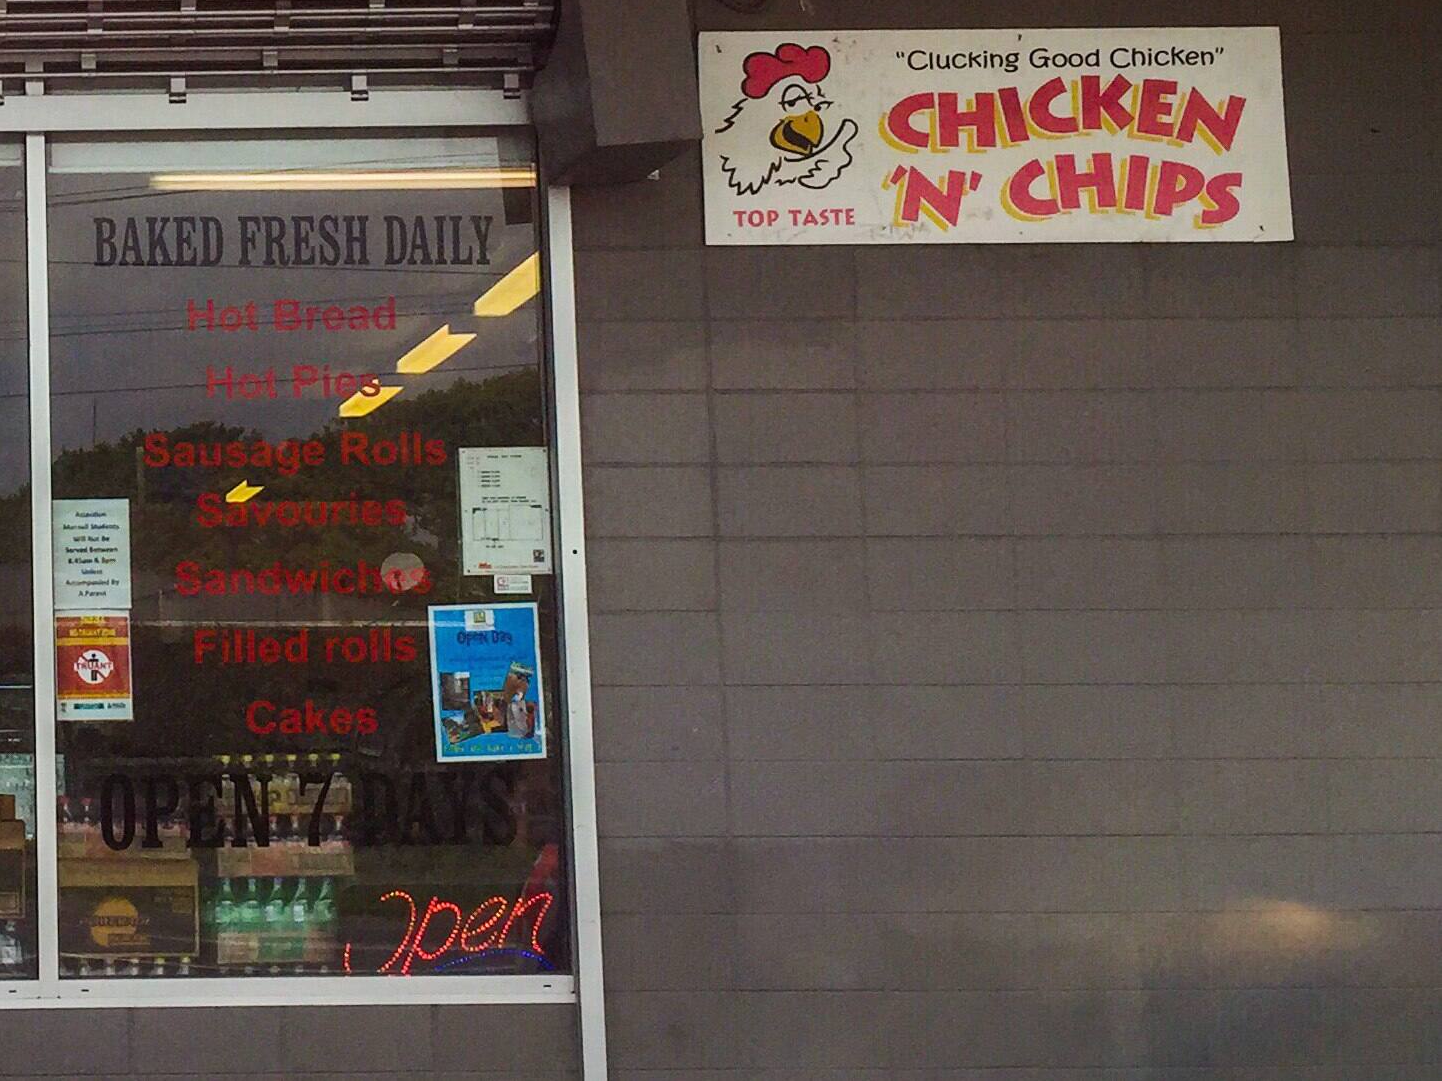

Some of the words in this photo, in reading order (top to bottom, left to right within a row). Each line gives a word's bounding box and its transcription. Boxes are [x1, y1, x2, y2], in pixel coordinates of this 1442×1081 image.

[1029, 47, 1101, 69] Good
[880, 73, 1247, 155] CHICKEN
[883, 164, 983, 231] 'N'
[1001, 152, 1243, 230] CHIPS
[733, 209, 780, 227] TOP
[788, 208, 856, 226] TASTE
[93, 216, 224, 267] BAKED
[238, 216, 369, 267] FRESH
[385, 214, 494, 266] DAILY
[187, 297, 258, 331] Hot
[273, 295, 398, 331] Bread
[206, 364, 279, 399] Hot
[293, 364, 383, 399] Pies
[143, 432, 326, 476] Sausage
[341, 431, 448, 467] Rolls
[196, 491, 407, 528] Savouries
[175, 557, 432, 596] Sandwiches
[194, 628, 309, 664] Filled
[325, 628, 417, 664] rolls
[76, 661, 113, 670] TRUANT
[245, 699, 379, 736] Cakes
[99, 770, 272, 851] OPEN
[299, 769, 334, 847] 7
[362, 768, 519, 847] DAYS
